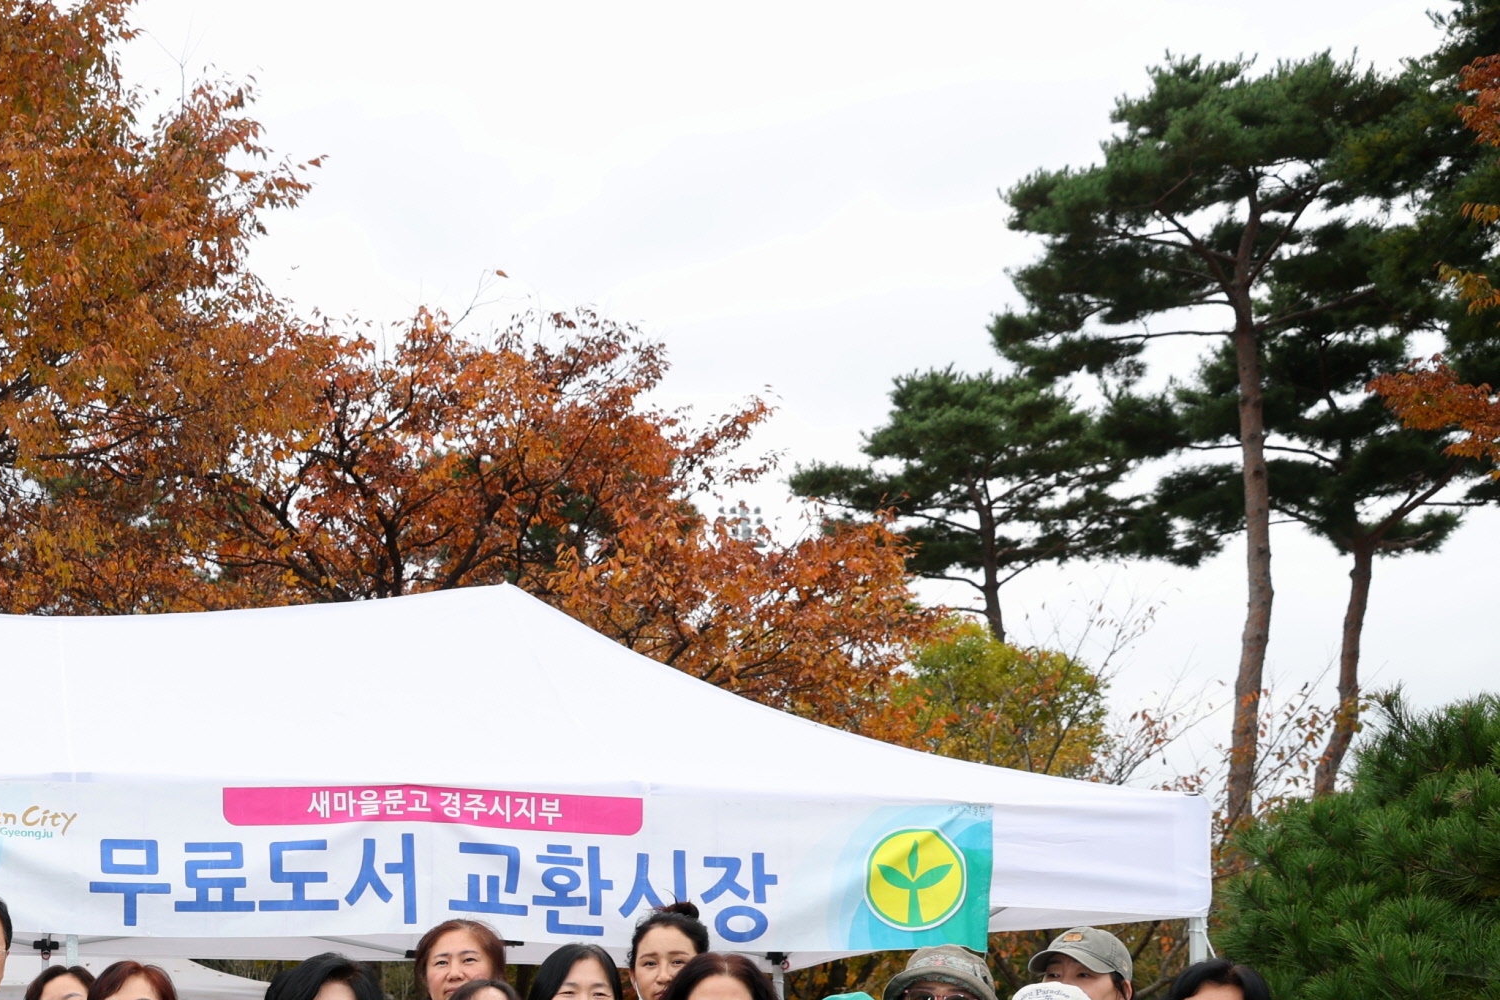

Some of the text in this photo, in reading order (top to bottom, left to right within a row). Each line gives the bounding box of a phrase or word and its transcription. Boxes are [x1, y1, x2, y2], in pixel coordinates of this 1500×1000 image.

[21, 806, 77, 836] City
[308, 790, 562, 825] 새마을문고 경주시지부
[89, 833, 778, 944] 무료도서 교환시장
